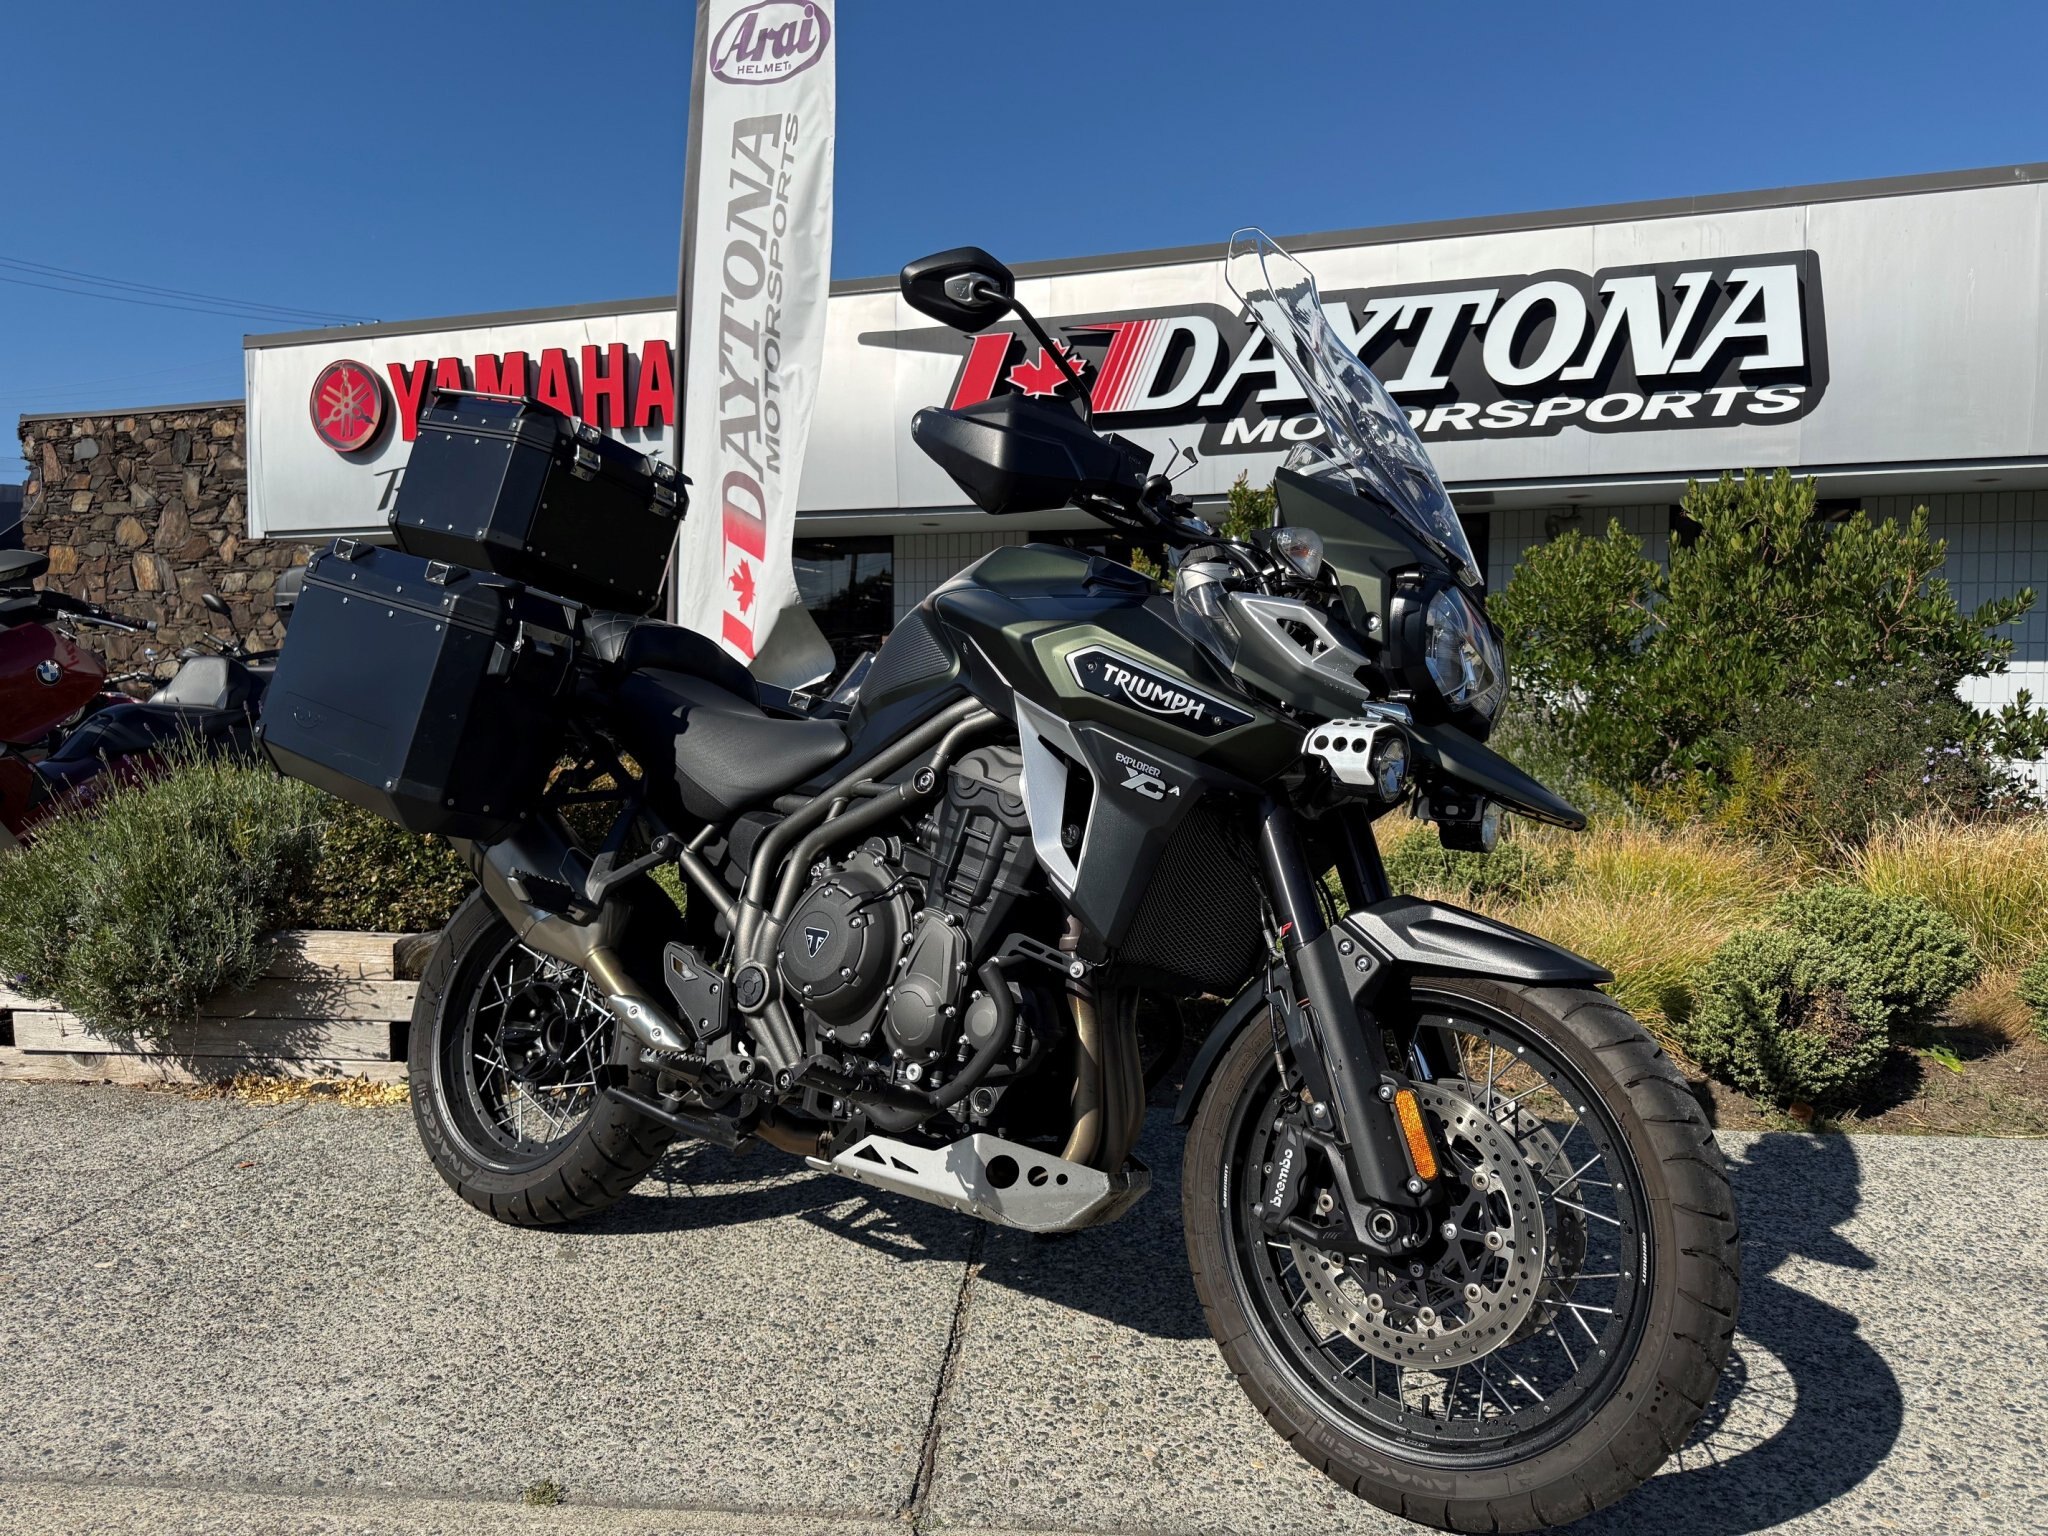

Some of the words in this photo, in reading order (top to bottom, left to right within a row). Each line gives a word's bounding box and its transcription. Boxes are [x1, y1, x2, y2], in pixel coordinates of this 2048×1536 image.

[713, 4, 816, 72] Arai
[737, 61, 789, 75] HELMET
[763, 113, 799, 475] MOTORSPORTS
[719, 113, 784, 562] DAYTONA
[1103, 663, 1205, 720] TRIUMPH
[1115, 752, 1161, 778] EXPLORER
[1269, 1148, 1293, 1208] brembo
